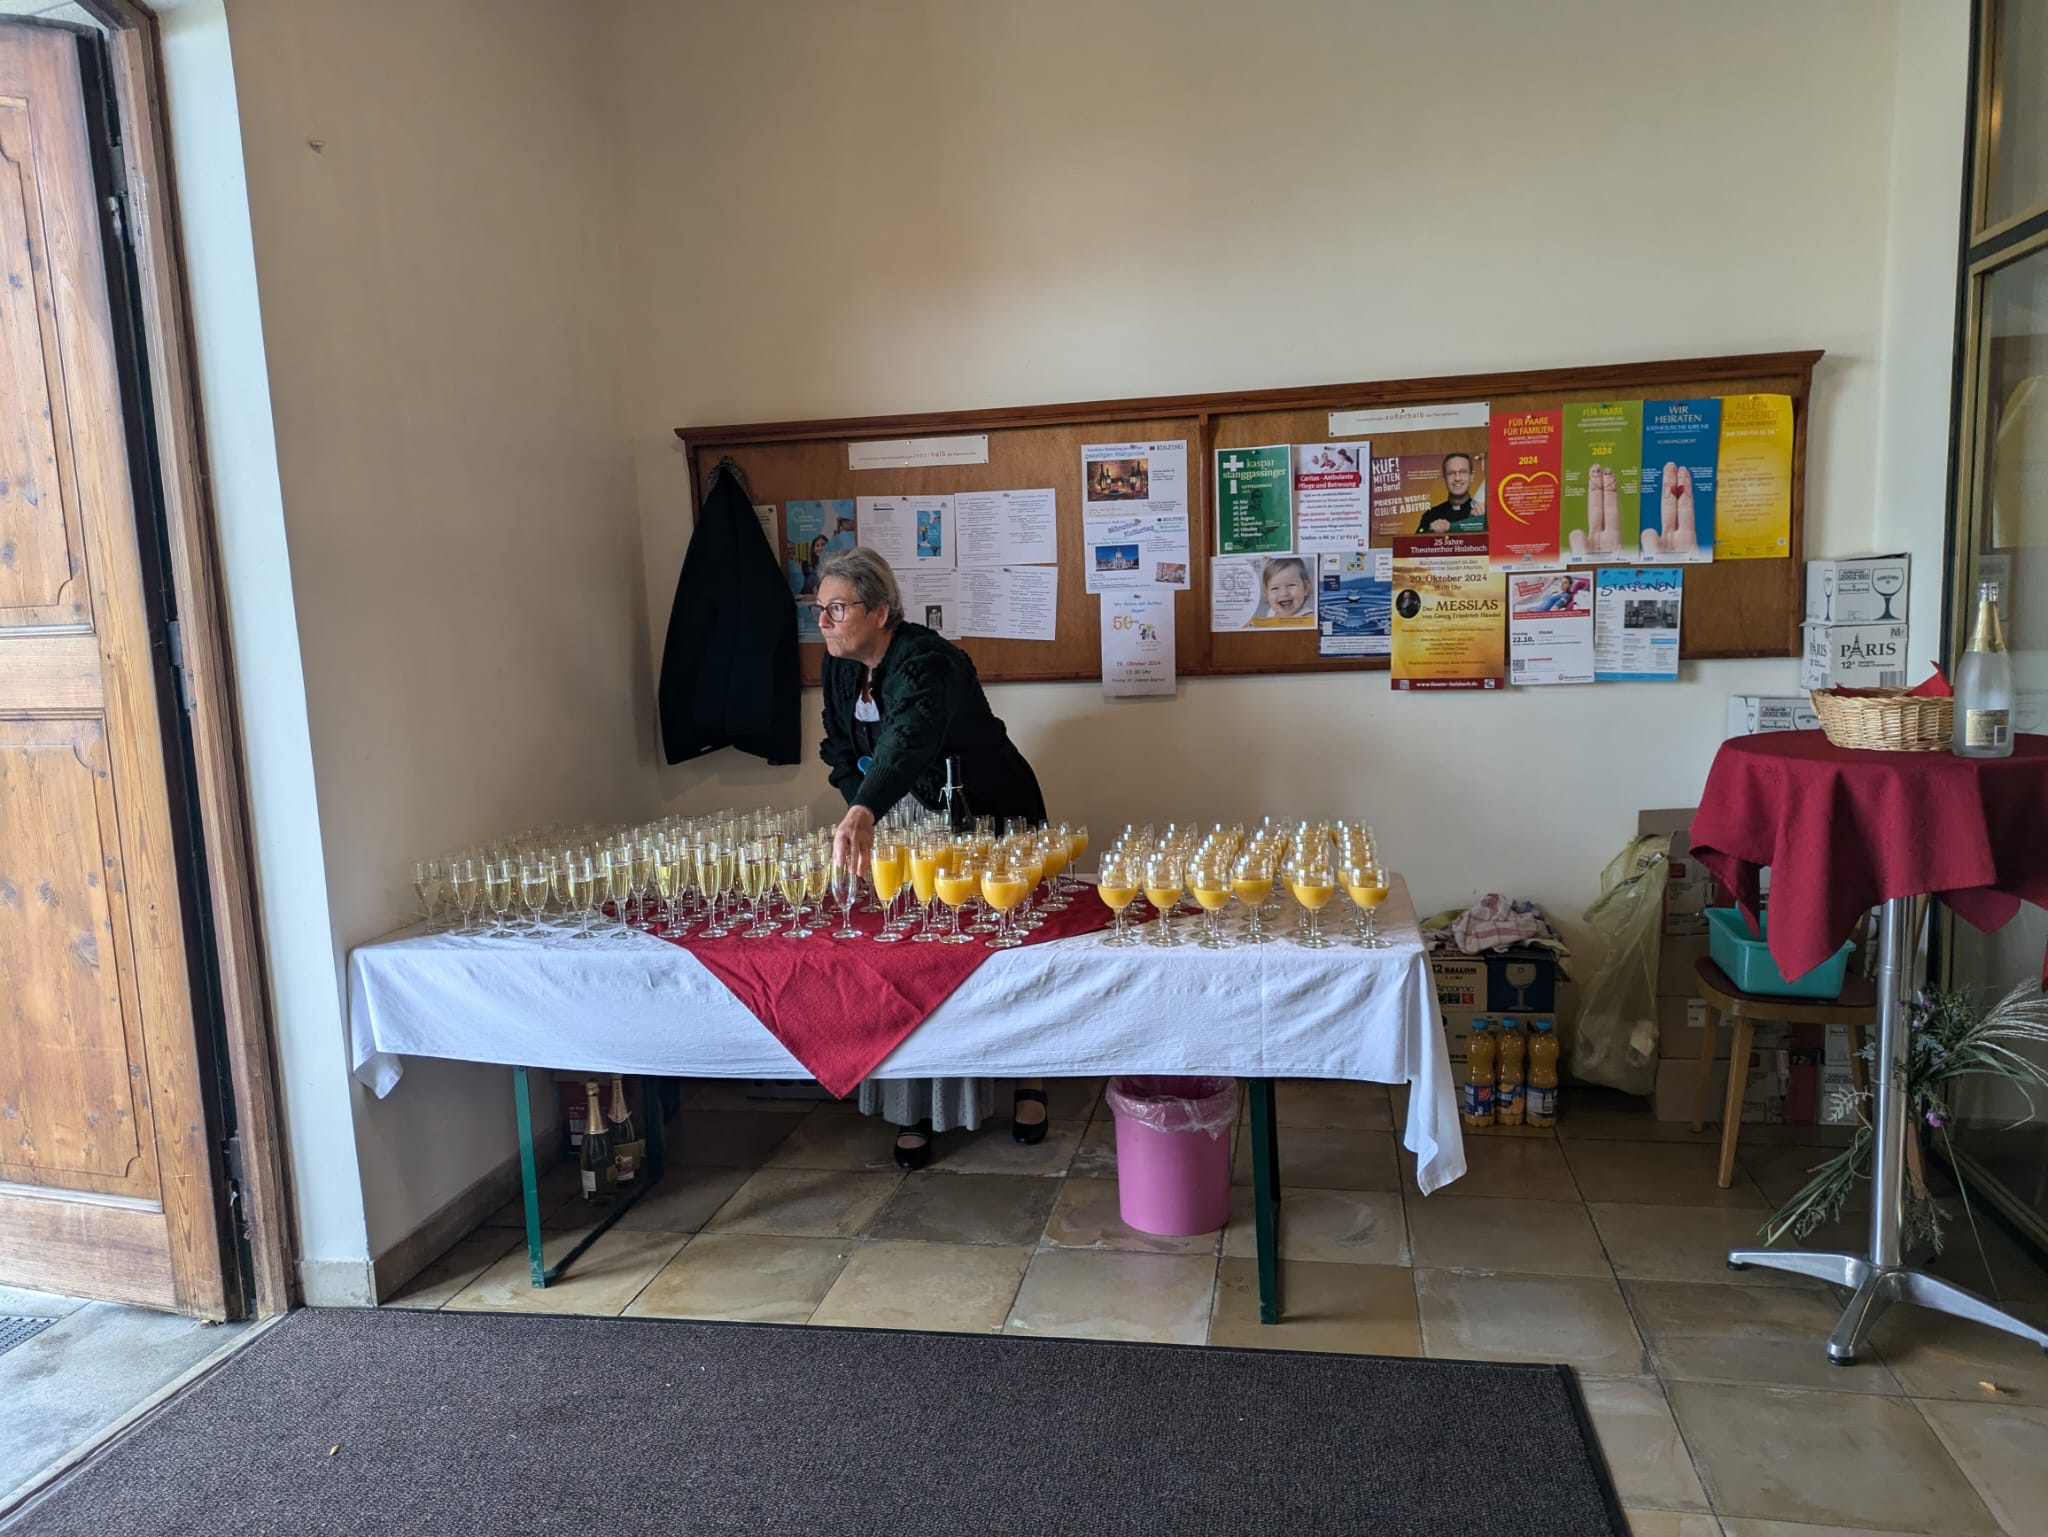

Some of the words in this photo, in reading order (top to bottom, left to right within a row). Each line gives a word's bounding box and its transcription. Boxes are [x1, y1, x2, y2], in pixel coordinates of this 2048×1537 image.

[1668, 405, 1689, 414] WIR
[1508, 417, 1523, 427] FÜR
[1525, 416, 1549, 426] PAARE
[1655, 414, 1702, 424] HEIRATEN
[1503, 427, 1518, 436] FÜR
[1519, 425, 1554, 435] FAMILIEN
[1591, 447, 1613, 456] 2024
[1246, 458, 1275, 470] kaspar
[1518, 456, 1538, 465] 2024
[1372, 457, 1400, 476] RUF!
[1222, 467, 1287, 481] stanggassinger
[1300, 474, 1319, 482] Caritas
[1323, 473, 1354, 481] Ambulante
[1373, 472, 1401, 485] MITTEN
[1383, 482, 1401, 492] Beruf
[1399, 501, 1432, 515] ABITUR
[1444, 538, 1464, 546] Jahre
[1410, 545, 1454, 554] Theaterchor
[1454, 544, 1488, 553] Halsbach
[1425, 573, 1463, 585] Oktober
[1464, 573, 1488, 582] 2024
[1435, 599, 1499, 612] MESSIAS
[1113, 615, 1133, 631] 50
[1809, 640, 1828, 657] PARIS
[1840, 635, 1896, 660] PARIS
